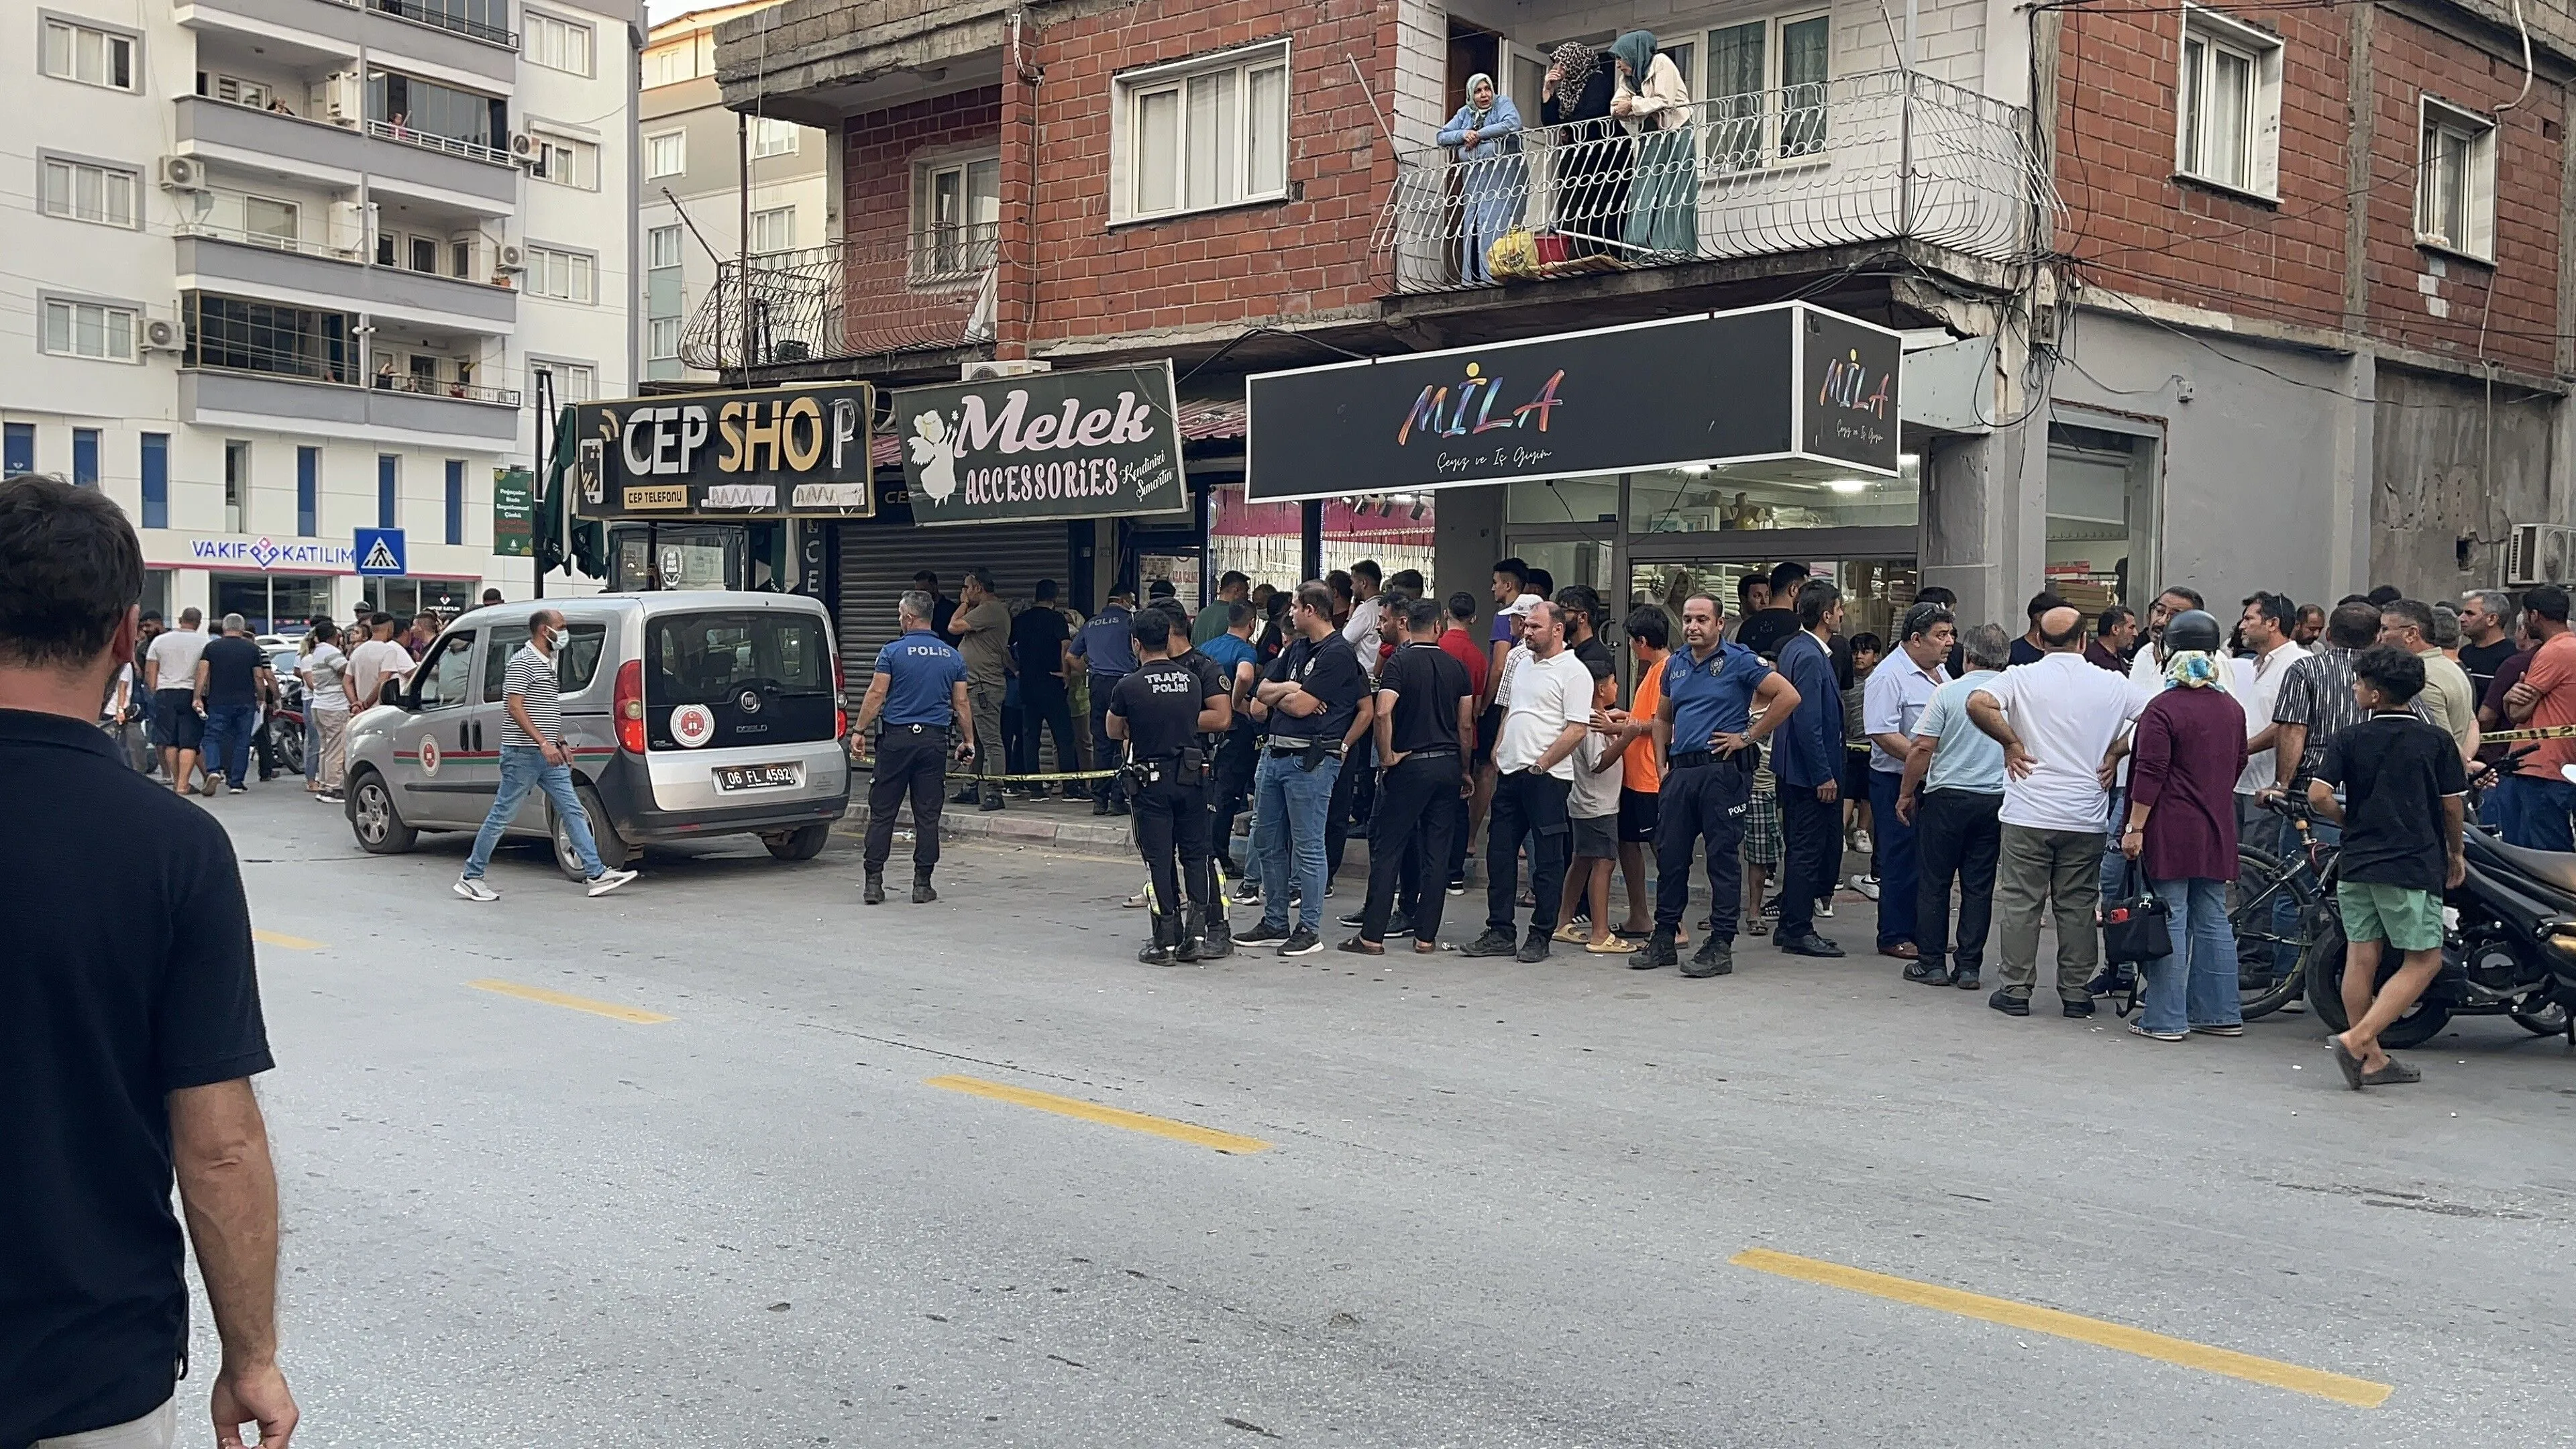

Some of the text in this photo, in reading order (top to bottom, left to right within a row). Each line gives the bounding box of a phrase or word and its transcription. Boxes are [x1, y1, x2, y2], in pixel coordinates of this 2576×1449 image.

[954, 389, 1155, 458] Melek
[623, 405, 710, 476] CEP
[1119, 449, 1166, 484] Kendinizi
[1437, 451, 1470, 474] Çeyiz
[1475, 455, 1487, 465] ve
[1513, 446, 1552, 468] Giyim
[629, 492, 643, 504] CEP
[1136, 469, 1173, 502] Şımartın
[191, 539, 356, 564] VAKIF KATILIM
[727, 768, 792, 785] 06 FL 4592
